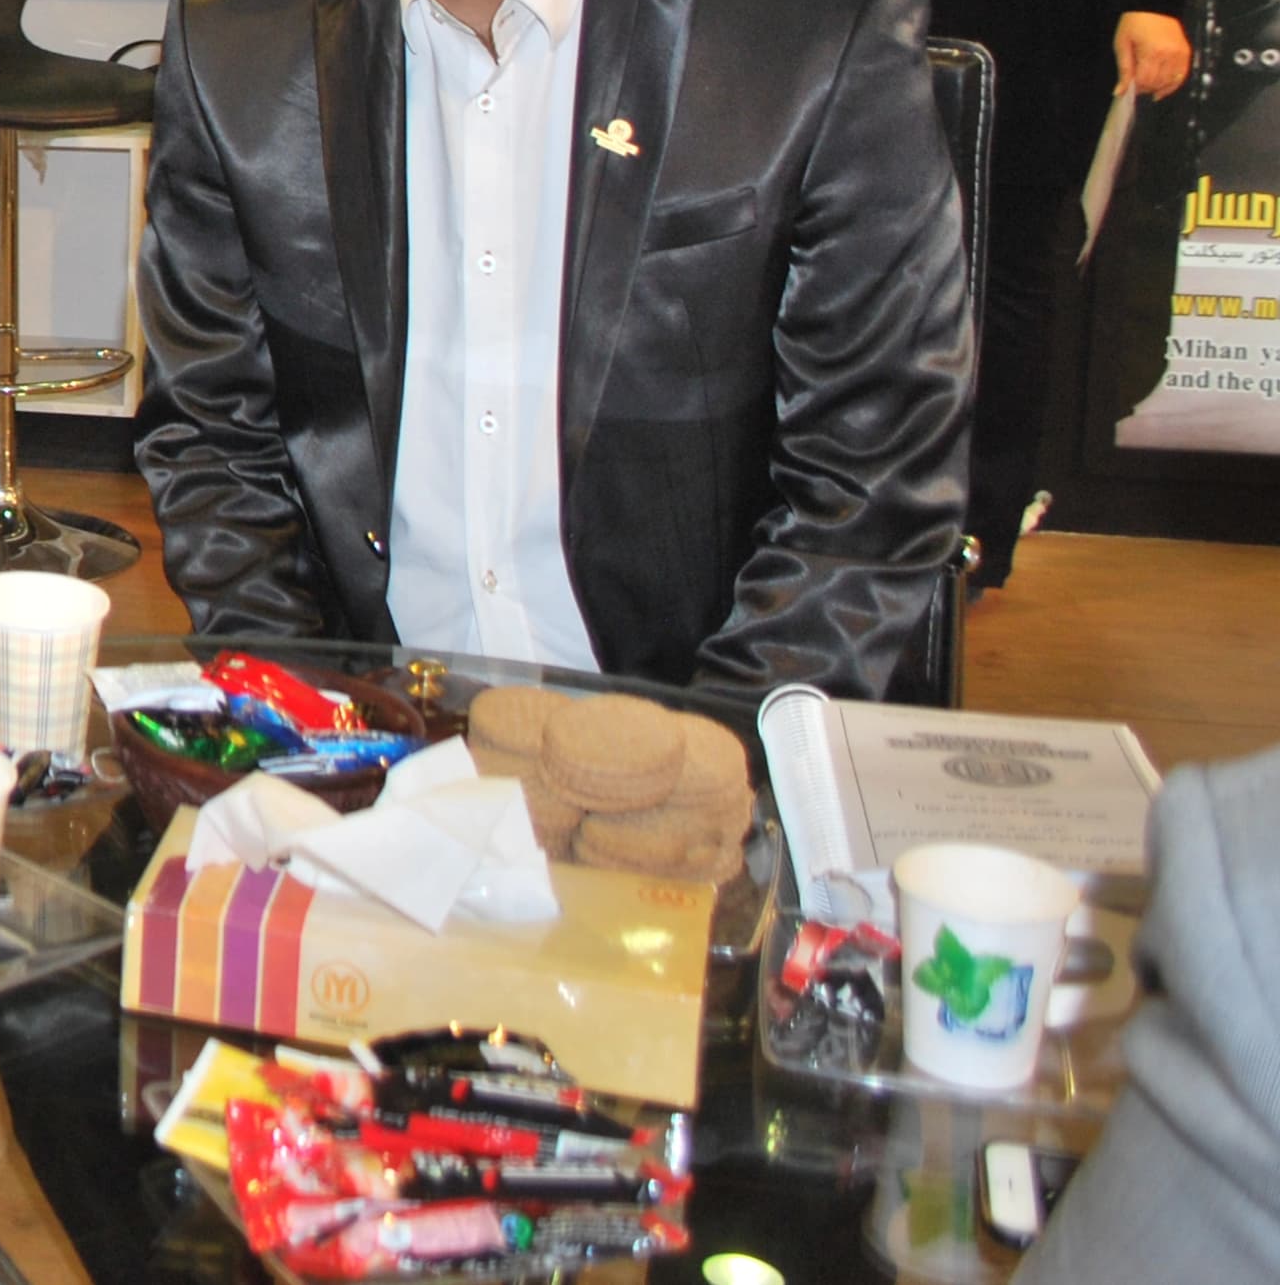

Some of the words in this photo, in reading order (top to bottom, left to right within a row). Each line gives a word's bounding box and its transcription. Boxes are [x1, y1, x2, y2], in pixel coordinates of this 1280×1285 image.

[1170, 337, 1247, 361] Mihan
[1166, 370, 1210, 389] and
[1217, 372, 1254, 391] the
